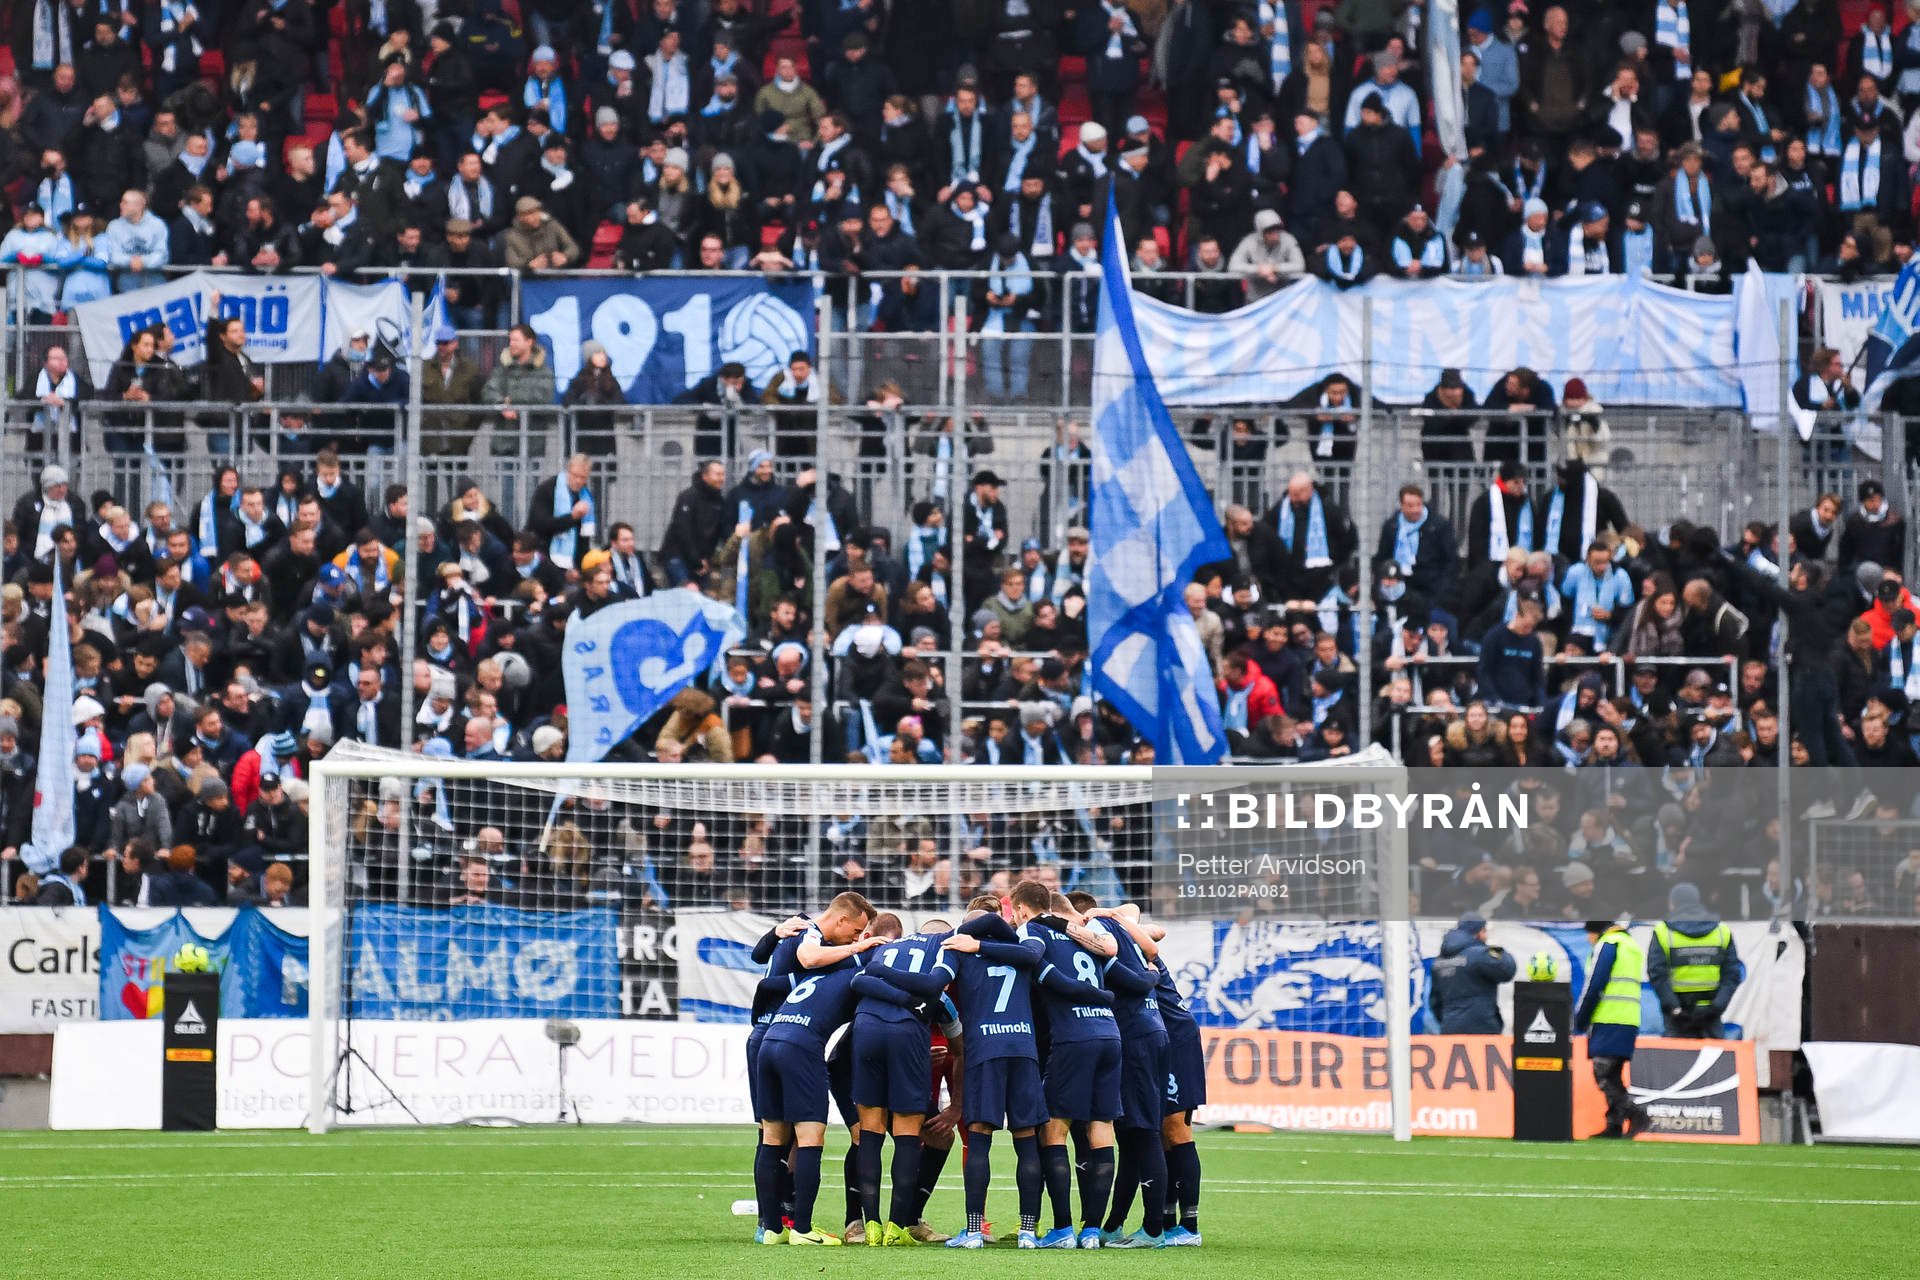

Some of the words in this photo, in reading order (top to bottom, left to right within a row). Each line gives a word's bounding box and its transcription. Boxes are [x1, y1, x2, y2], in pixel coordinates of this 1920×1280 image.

[883, 947, 926, 974] 11
[786, 974, 827, 1004] 6
[986, 965, 1017, 1013] 7
[563, 1033, 749, 1080] MEDI
